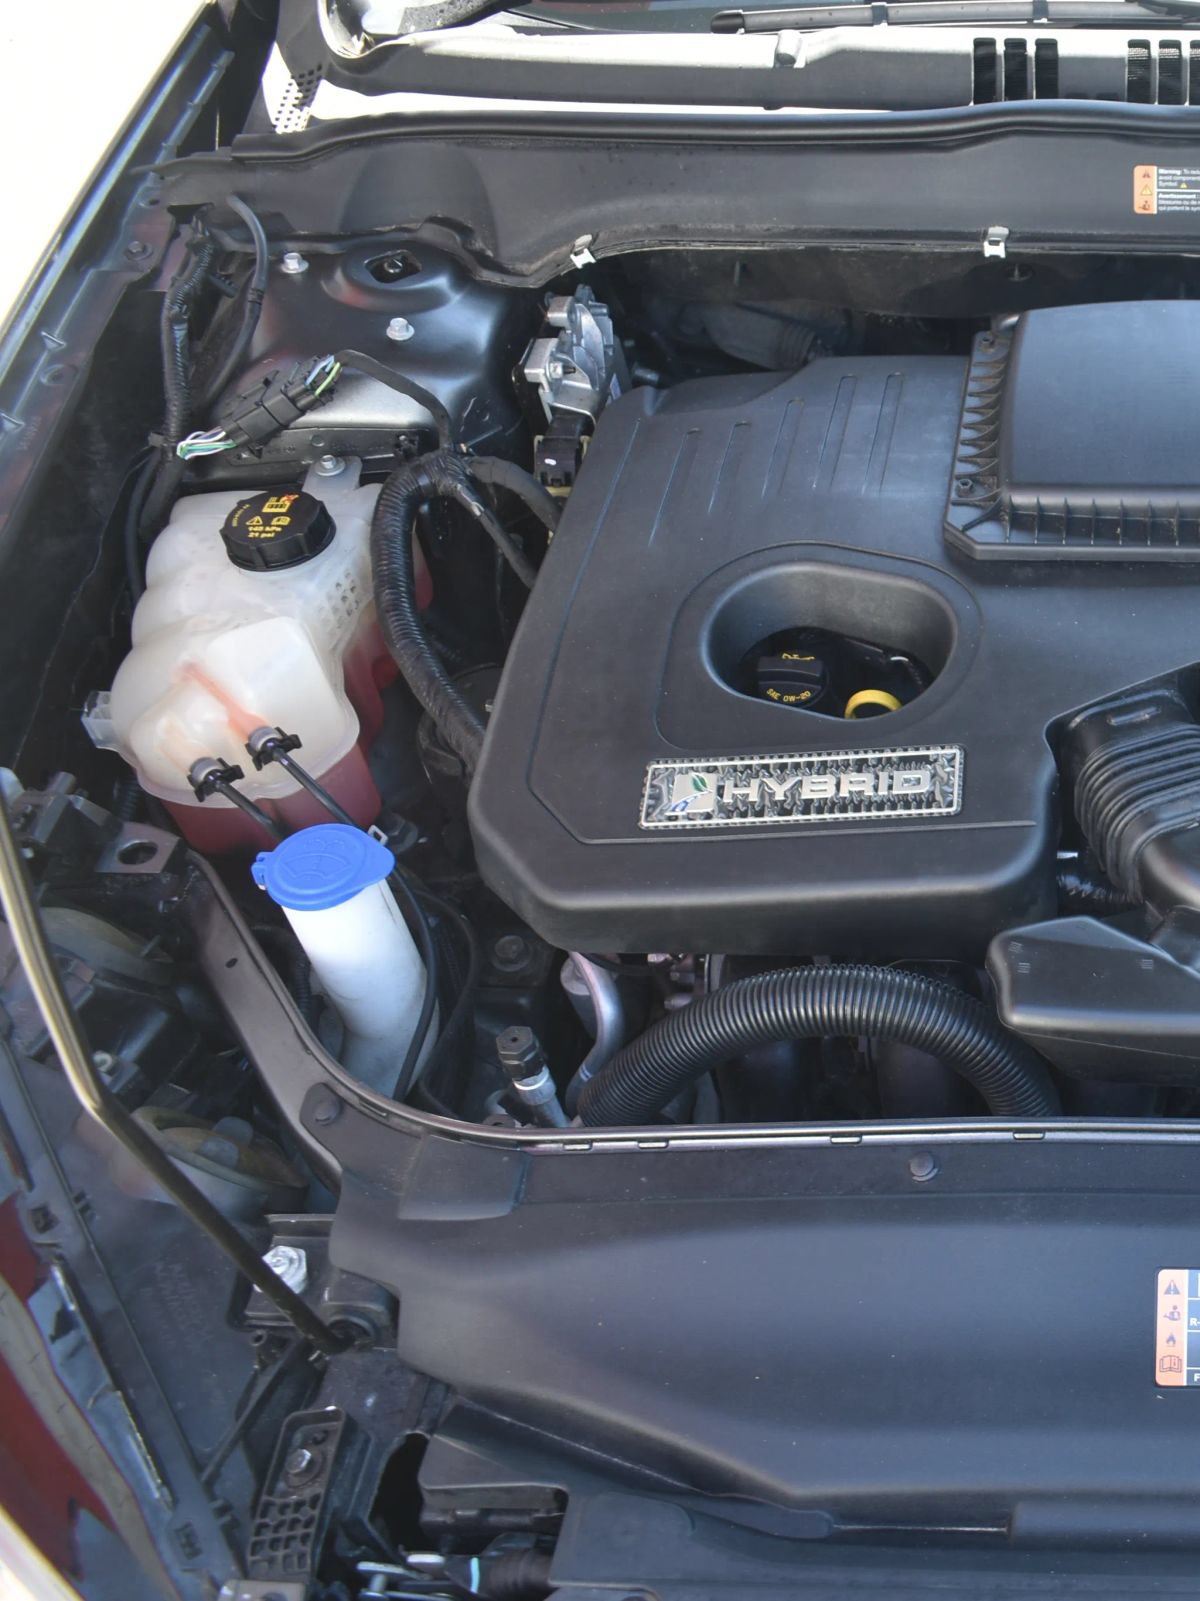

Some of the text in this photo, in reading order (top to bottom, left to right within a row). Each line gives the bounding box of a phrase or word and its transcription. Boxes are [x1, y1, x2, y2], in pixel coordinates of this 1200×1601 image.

[766, 688, 812, 702] SAE 0W-20
[723, 770, 934, 804] HYBRID
